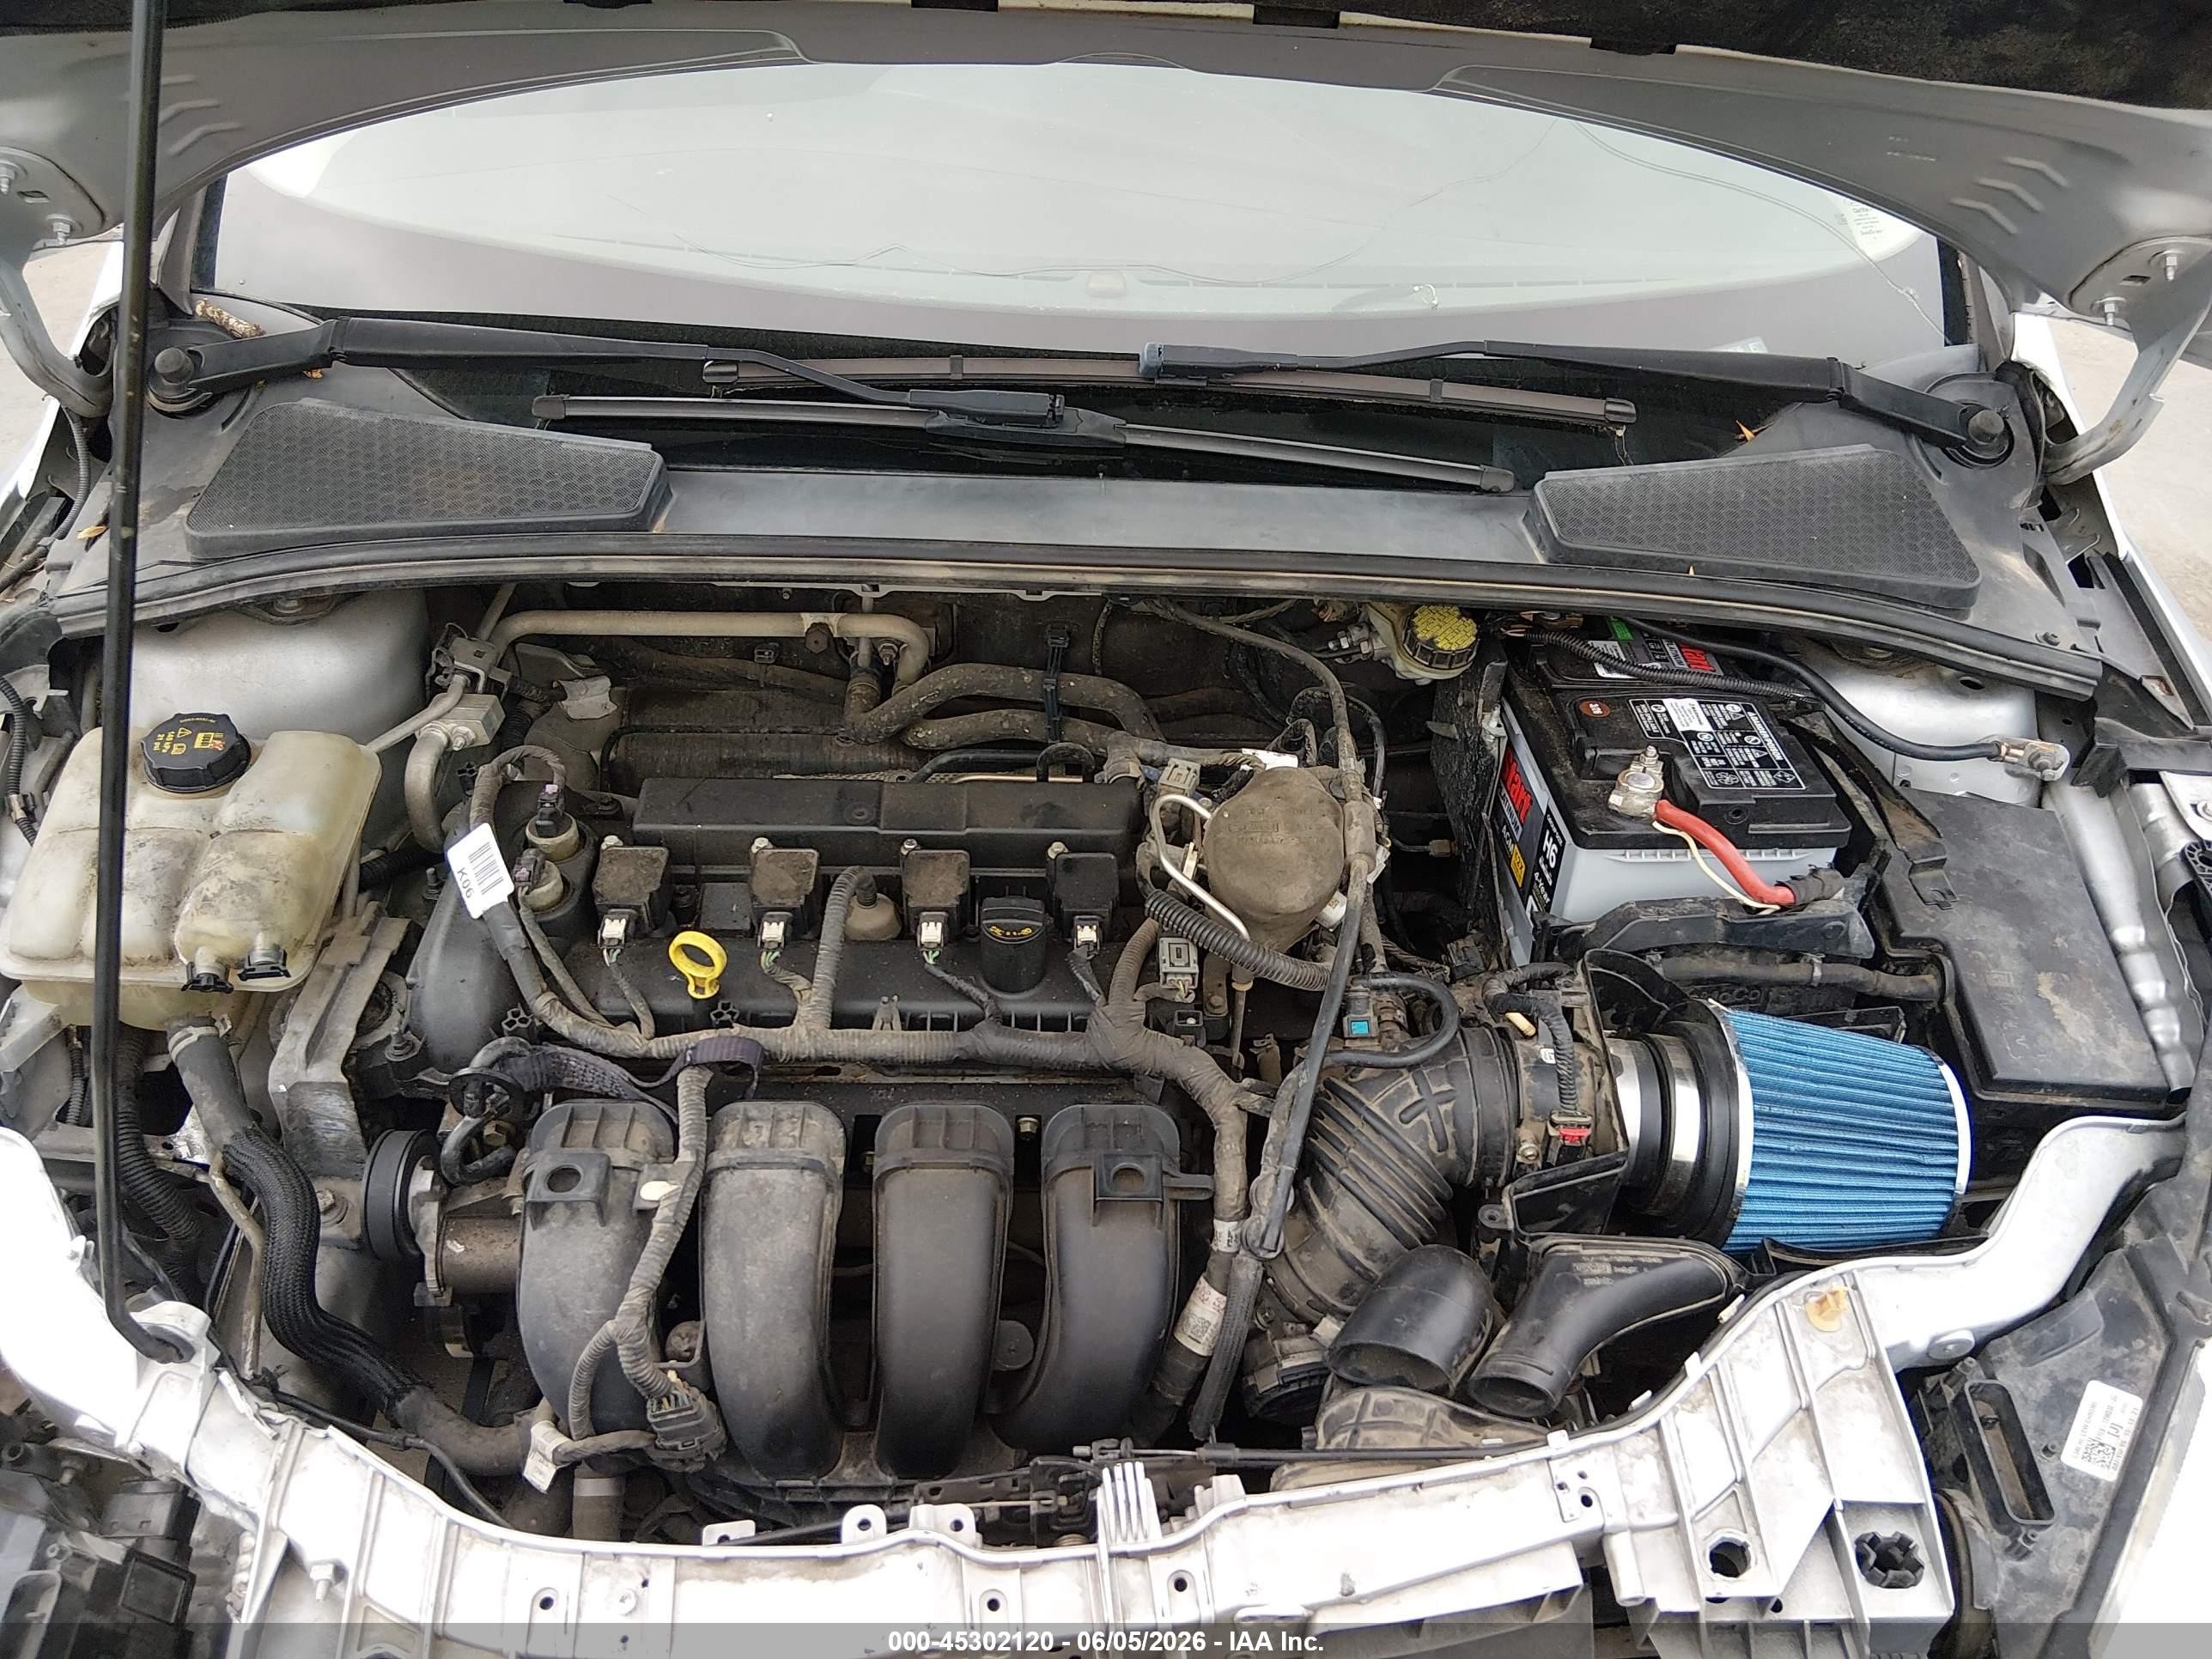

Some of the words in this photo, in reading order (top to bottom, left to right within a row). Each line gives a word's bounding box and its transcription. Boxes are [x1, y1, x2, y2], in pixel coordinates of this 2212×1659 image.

[1543, 830, 1559, 868] H6
[457, 867, 474, 898] K06
[1534, 872, 1551, 904] 4-Year
